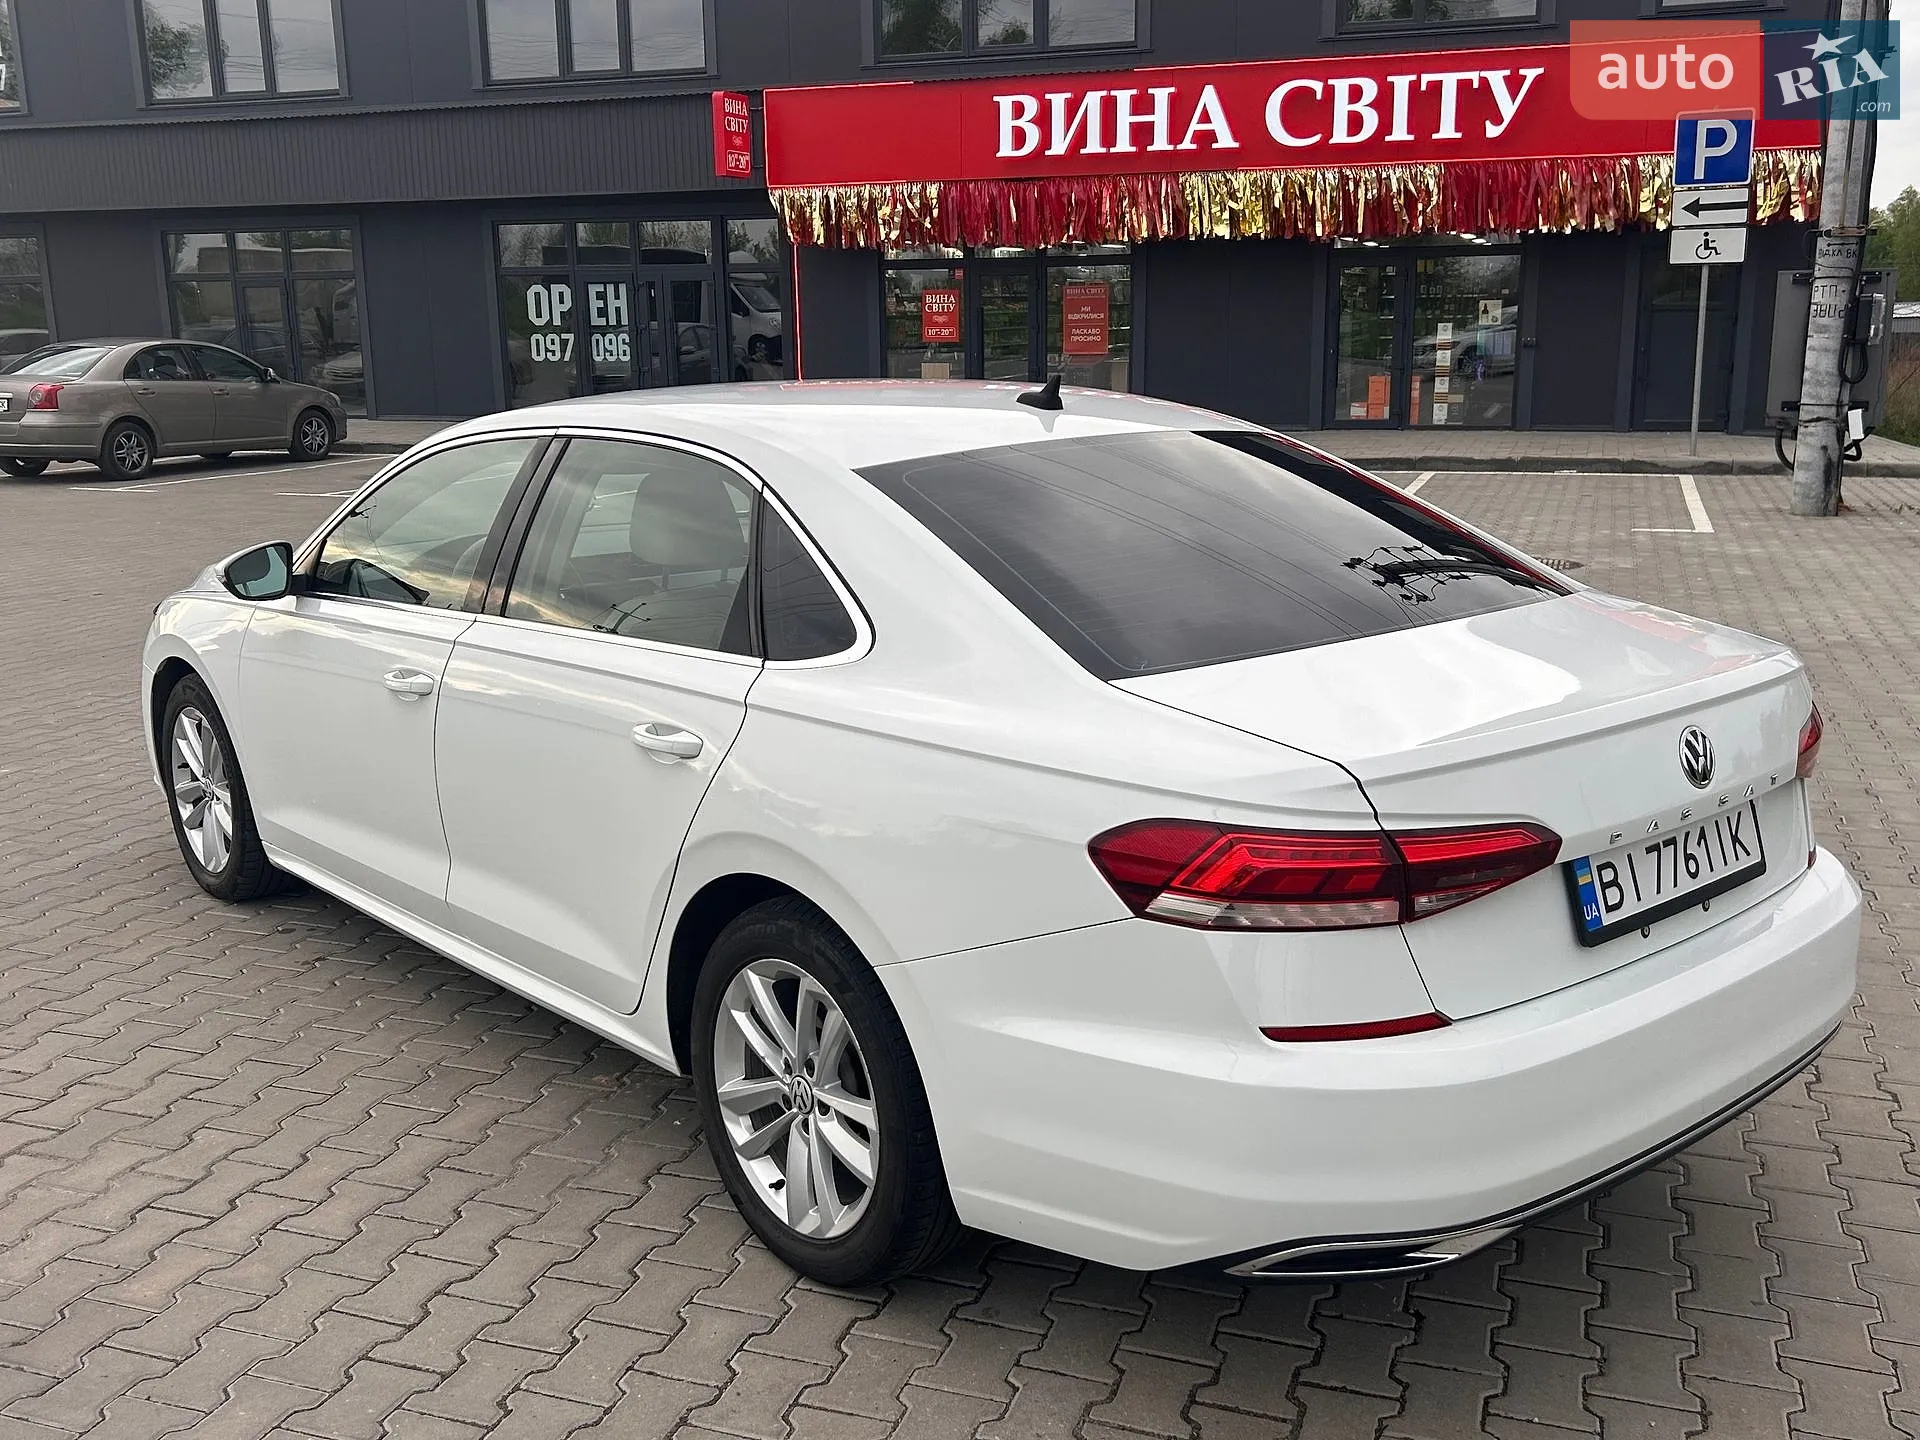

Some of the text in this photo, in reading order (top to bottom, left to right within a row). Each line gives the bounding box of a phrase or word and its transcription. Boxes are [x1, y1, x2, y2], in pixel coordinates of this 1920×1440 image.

[724, 98, 748, 116] ВИНА
[992, 67, 1545, 158] ВИНА СВІТУ
[725, 116, 748, 133] СВІТУ
[1694, 119, 1738, 180] P
[925, 303, 955, 312] СВІТУ
[926, 294, 955, 303] ВИНА
[530, 333, 631, 361] 097 096
[1645, 825, 1714, 895] 7761
[1583, 903, 1599, 921] UA
